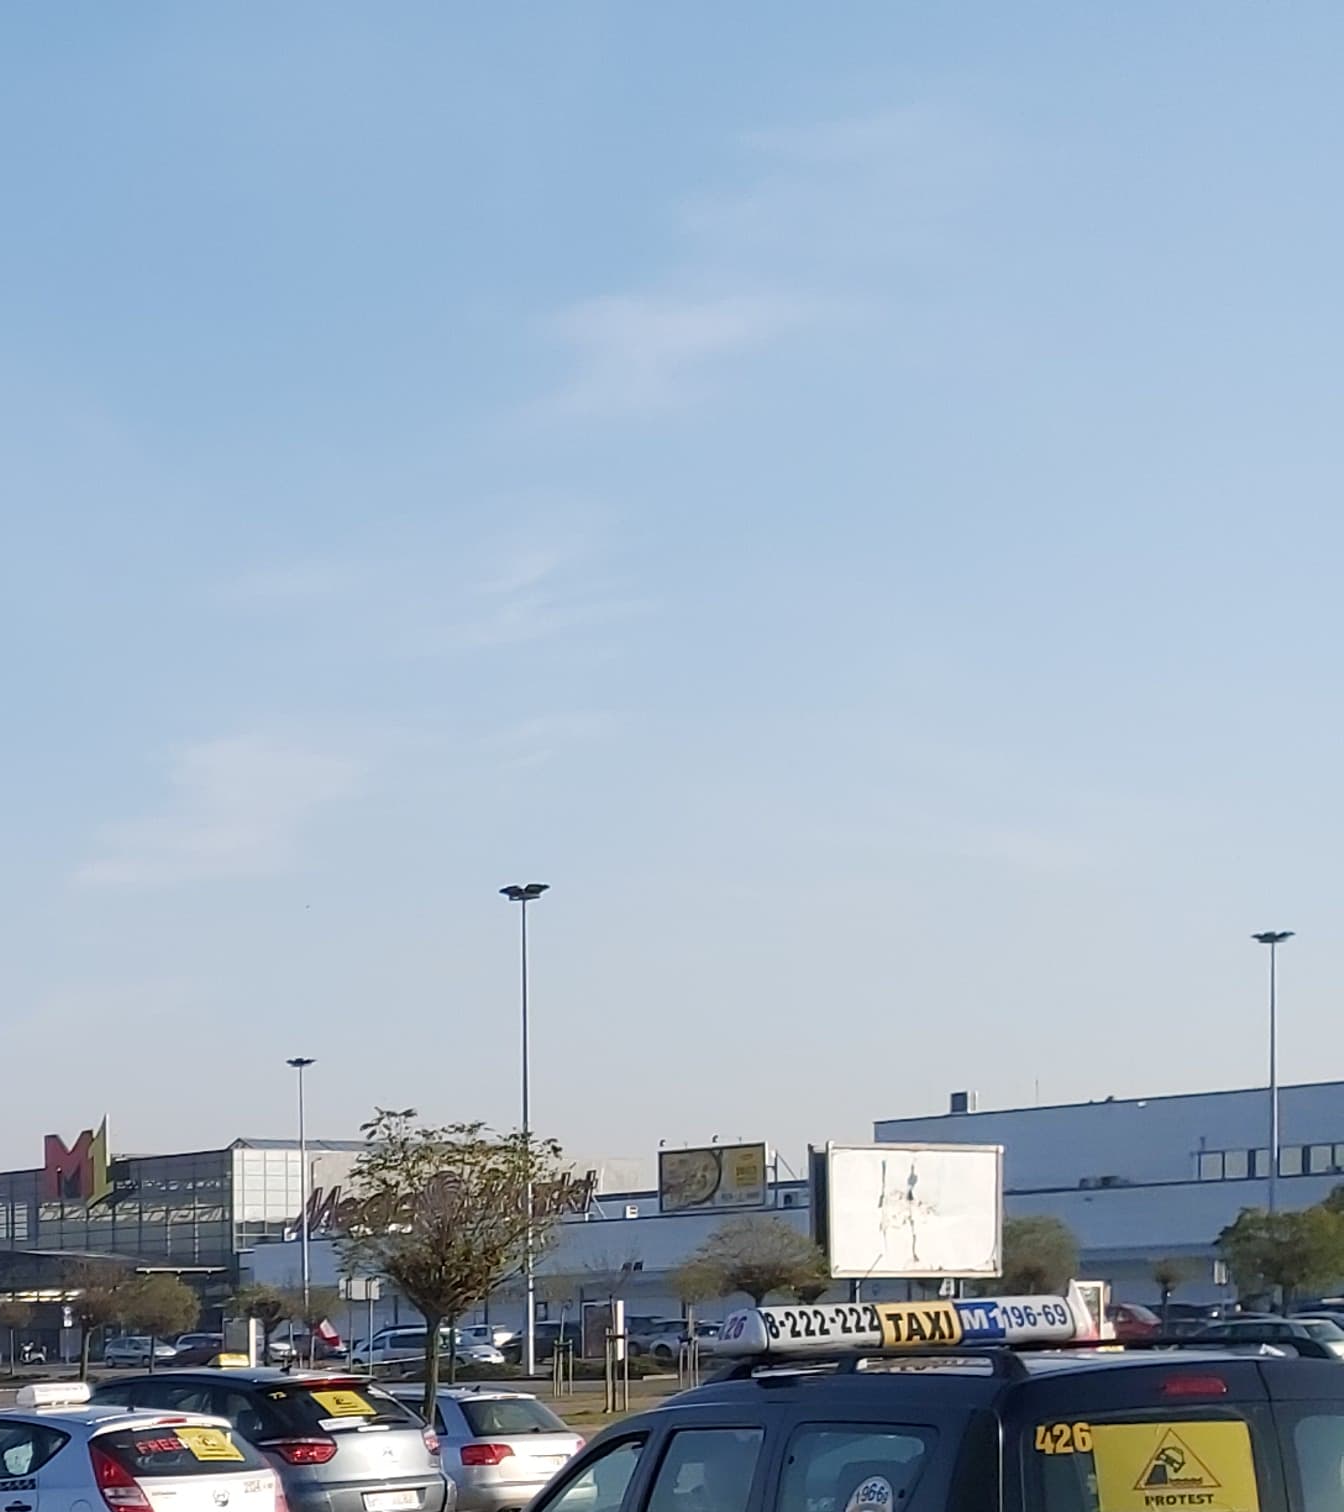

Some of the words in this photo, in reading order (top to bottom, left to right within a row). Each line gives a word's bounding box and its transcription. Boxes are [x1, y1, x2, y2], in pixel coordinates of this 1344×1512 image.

[885, 1310, 954, 1342] TAXI
[1035, 1422, 1094, 1455] 426
[1144, 1493, 1215, 1506] PROTEST
